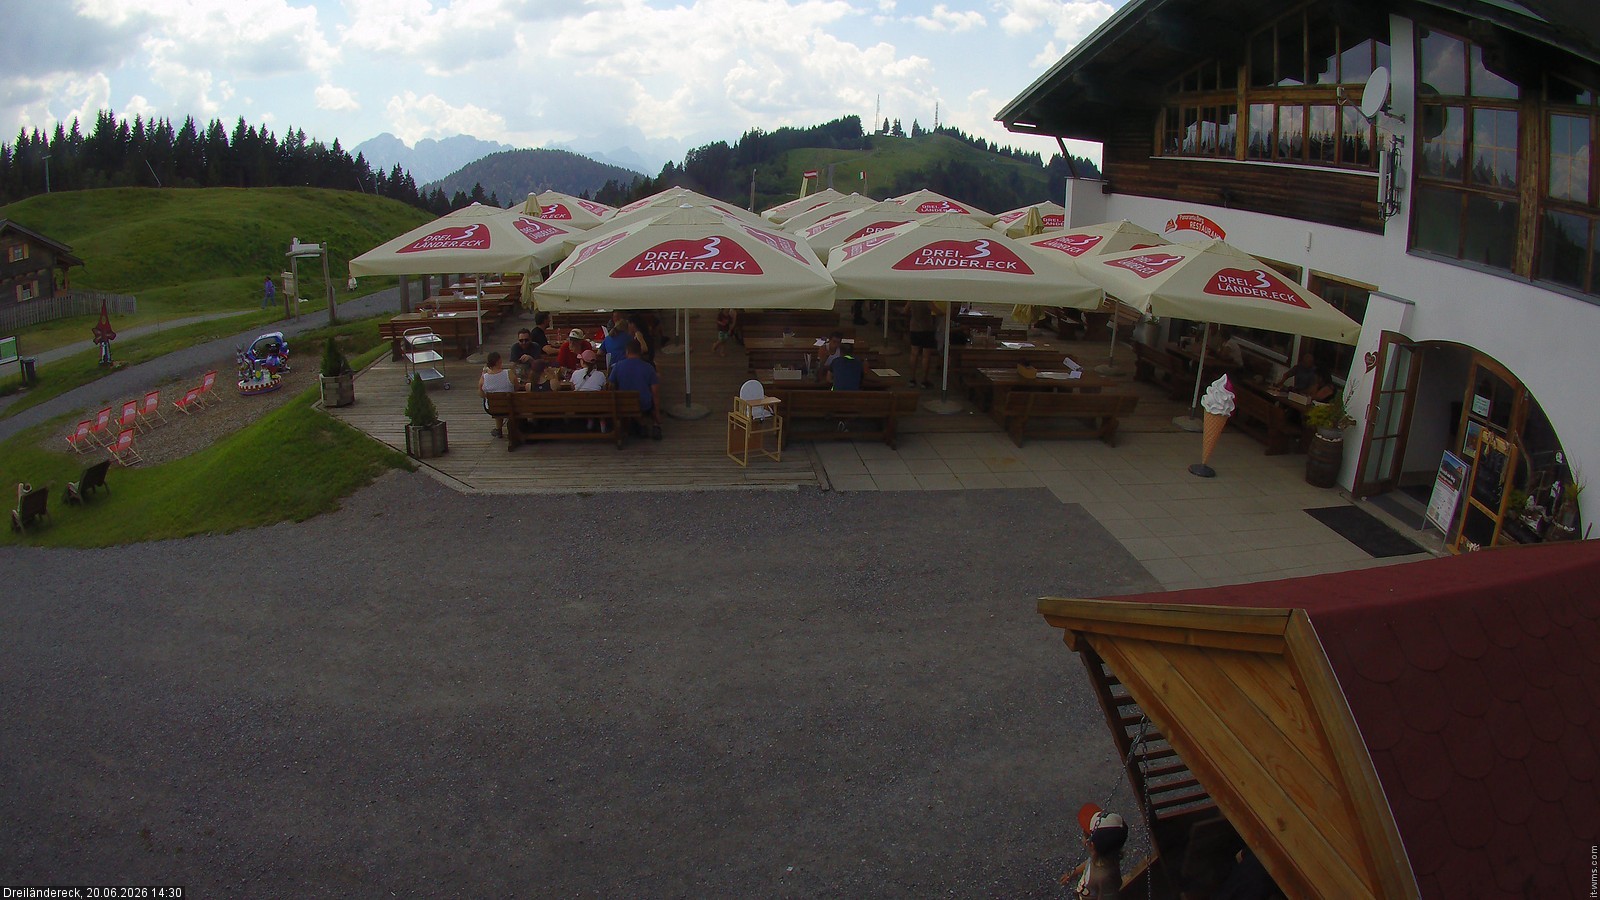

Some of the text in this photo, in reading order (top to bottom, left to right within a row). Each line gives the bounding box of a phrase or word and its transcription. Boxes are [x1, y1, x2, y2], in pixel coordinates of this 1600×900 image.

[412, 239, 485, 249] LÄNDER.ECK
[644, 251, 689, 260] DREI.
[921, 248, 963, 258] DREI.
[634, 260, 747, 271] LÄNDER.ECK
[914, 257, 1018, 270] LÄNDER.ECK
[1218, 274, 1252, 287] DREI.
[1217, 282, 1297, 303] LÄNDER.ECK
